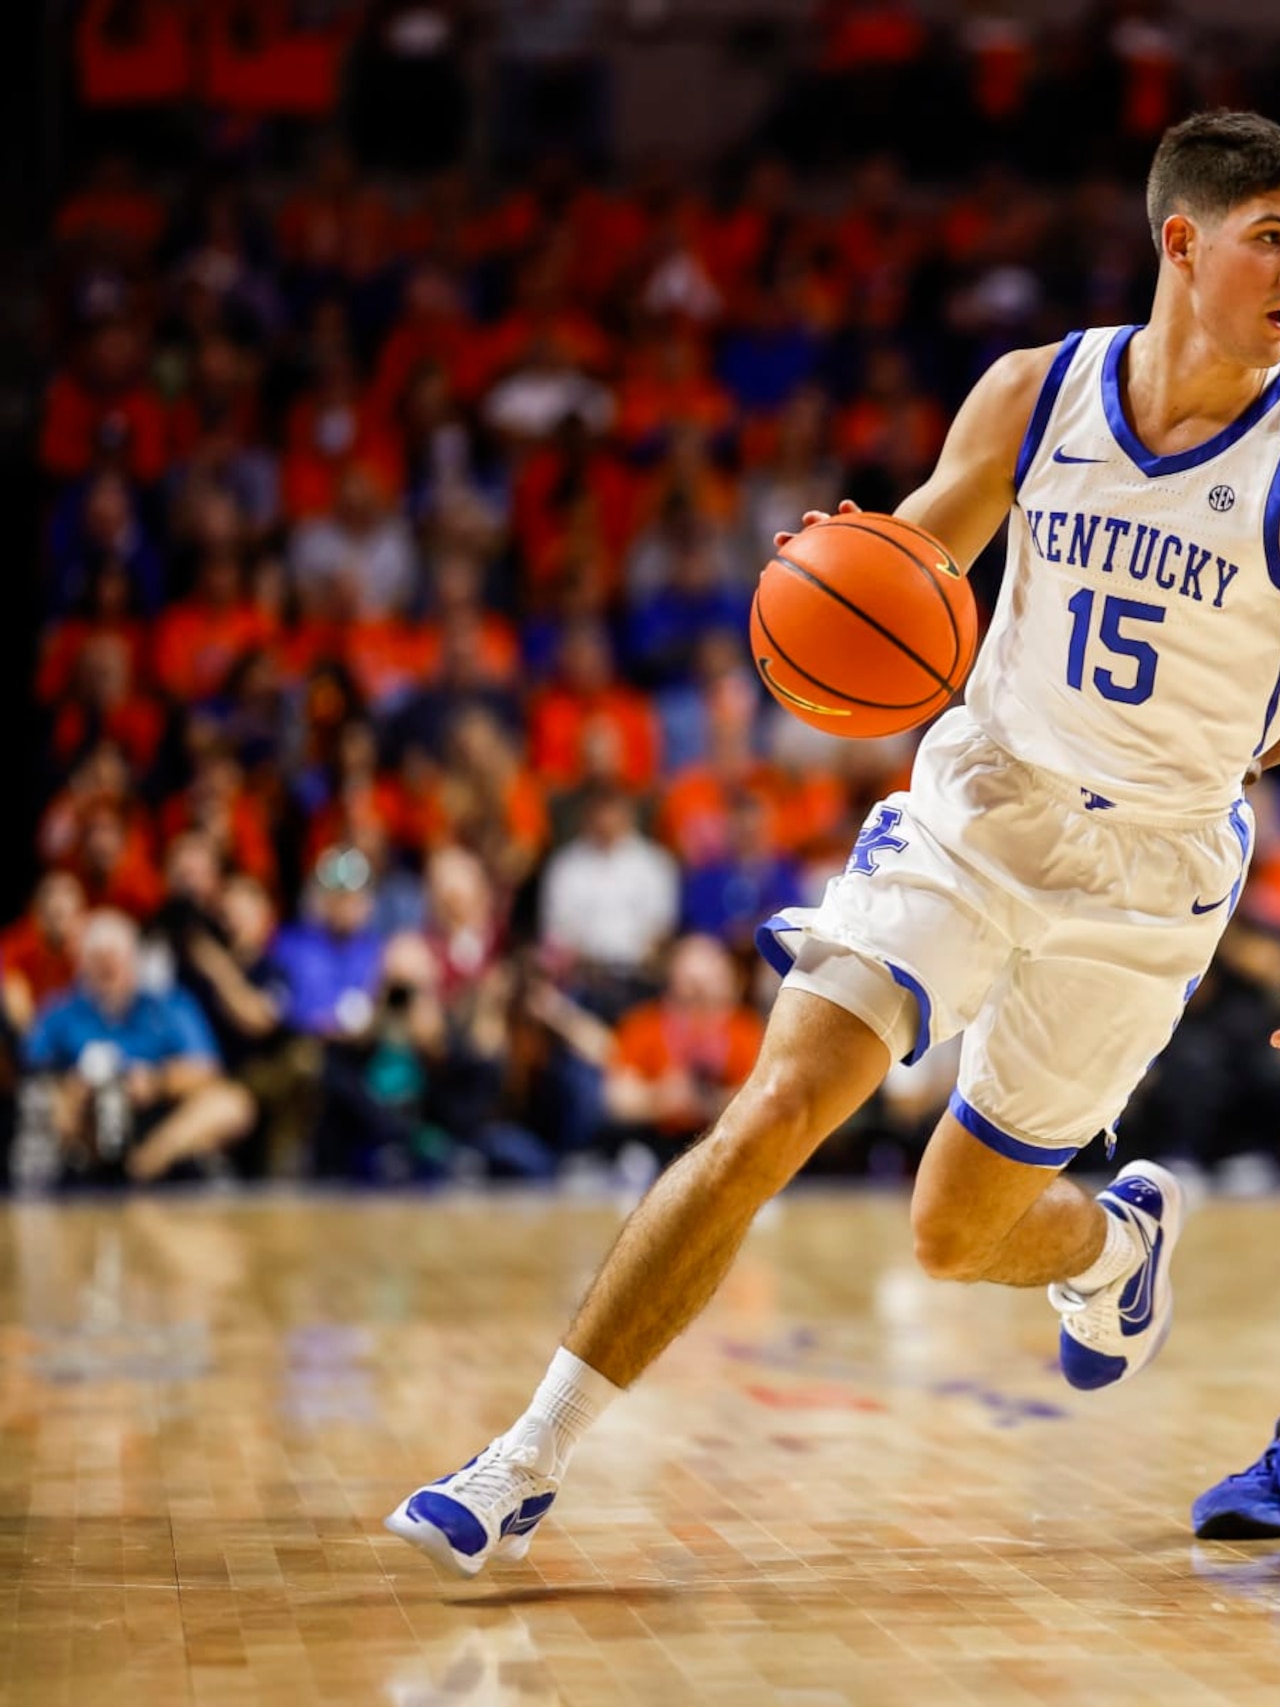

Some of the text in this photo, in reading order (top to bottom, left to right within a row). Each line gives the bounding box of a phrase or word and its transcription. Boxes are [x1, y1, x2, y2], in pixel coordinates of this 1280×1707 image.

[1209, 485, 1235, 512] SEC
[1026, 510, 1239, 608] KENTUCKY
[1066, 587, 1167, 706] 15
